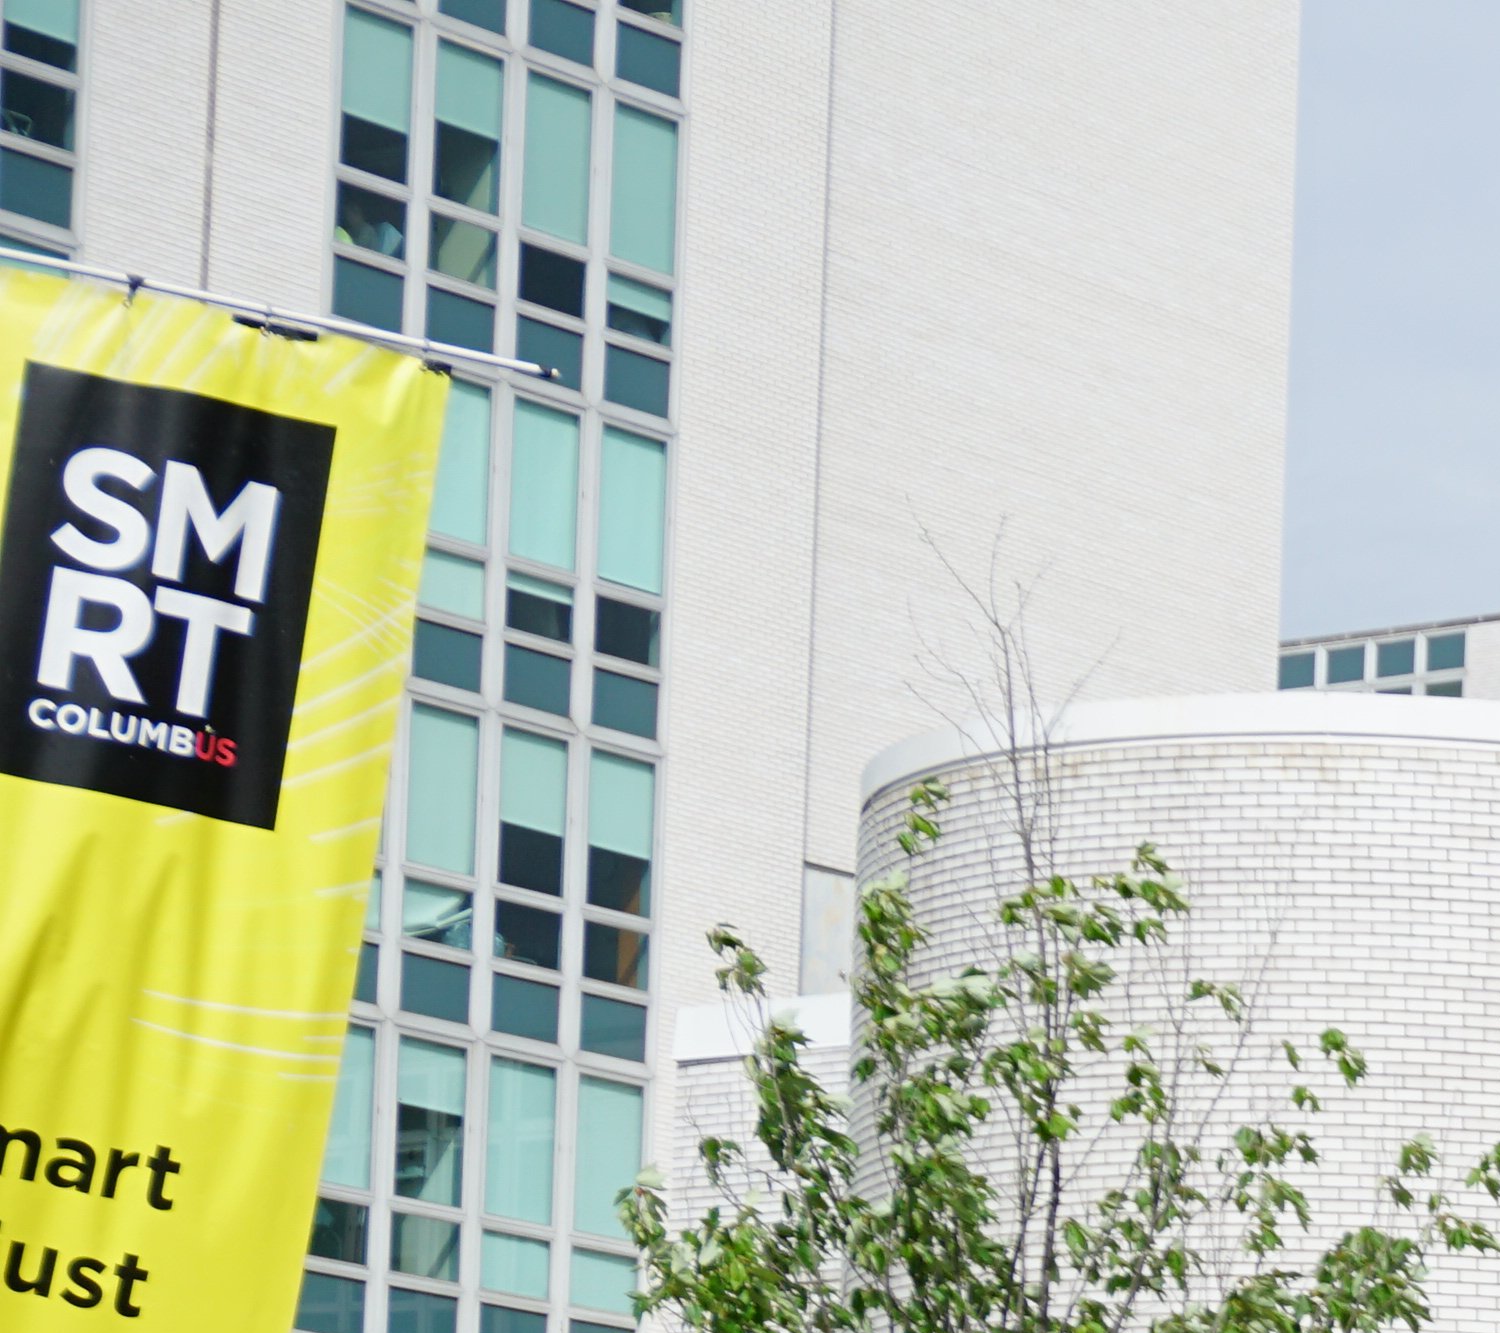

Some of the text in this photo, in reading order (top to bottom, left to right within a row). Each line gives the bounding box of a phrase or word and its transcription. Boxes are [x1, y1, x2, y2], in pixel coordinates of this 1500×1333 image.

[50, 446, 282, 603] SM
[36, 564, 256, 719] RT
[27, 696, 238, 768] COLUMBUS
[0, 1219, 149, 1318] ust
